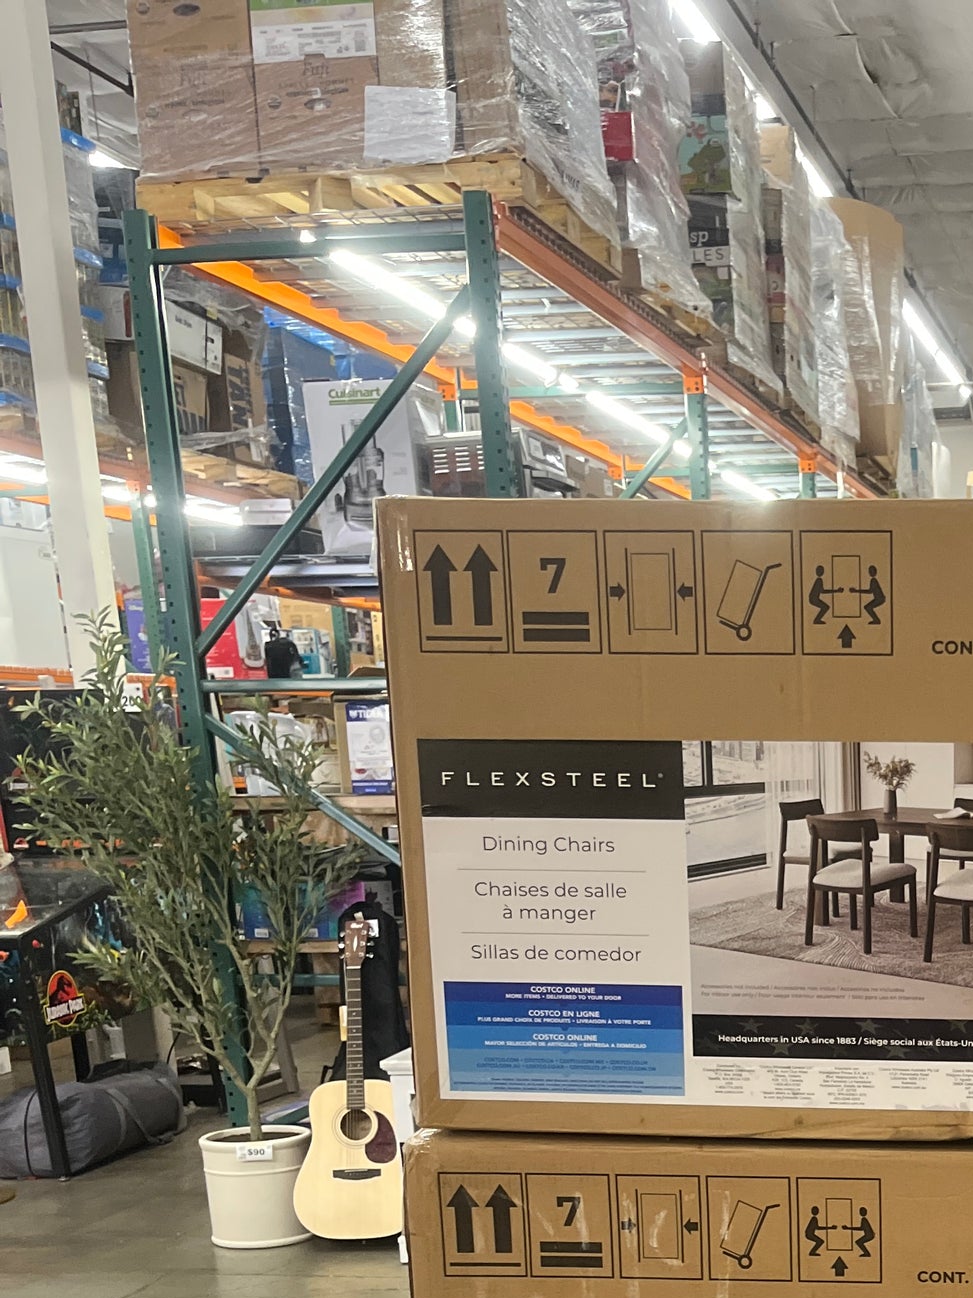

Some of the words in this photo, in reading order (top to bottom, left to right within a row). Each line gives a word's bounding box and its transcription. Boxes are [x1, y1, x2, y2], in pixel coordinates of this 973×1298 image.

[328, 387, 381, 399] Cuisinart
[540, 557, 567, 594] 7
[441, 771, 657, 788] FLEXSTEEL
[483, 836, 548, 855] Dining
[554, 836, 615, 853] Chairs
[475, 881, 549, 897] Chaises
[555, 882, 579, 898] de
[585, 883, 627, 898] salle
[503, 904, 513, 920] à
[520, 908, 597, 924] manger
[472, 944, 519, 960] Sillas
[525, 945, 549, 961] de
[555, 945, 642, 962] comedor
[528, 1009, 560, 1017] COSTCO
[577, 1010, 600, 1018] LIGNE
[533, 1033, 565, 1041] COSTCO
[719, 1035, 778, 1044] Headquarters
[791, 1036, 810, 1044] USA
[837, 1036, 857, 1044] 1883
[864, 1037, 888, 1047] Siège
[890, 1038, 915, 1046] social
[247, 1148, 266, 1156] $90
[556, 1196, 581, 1227] 7
[917, 1271, 969, 1284] CONT.
